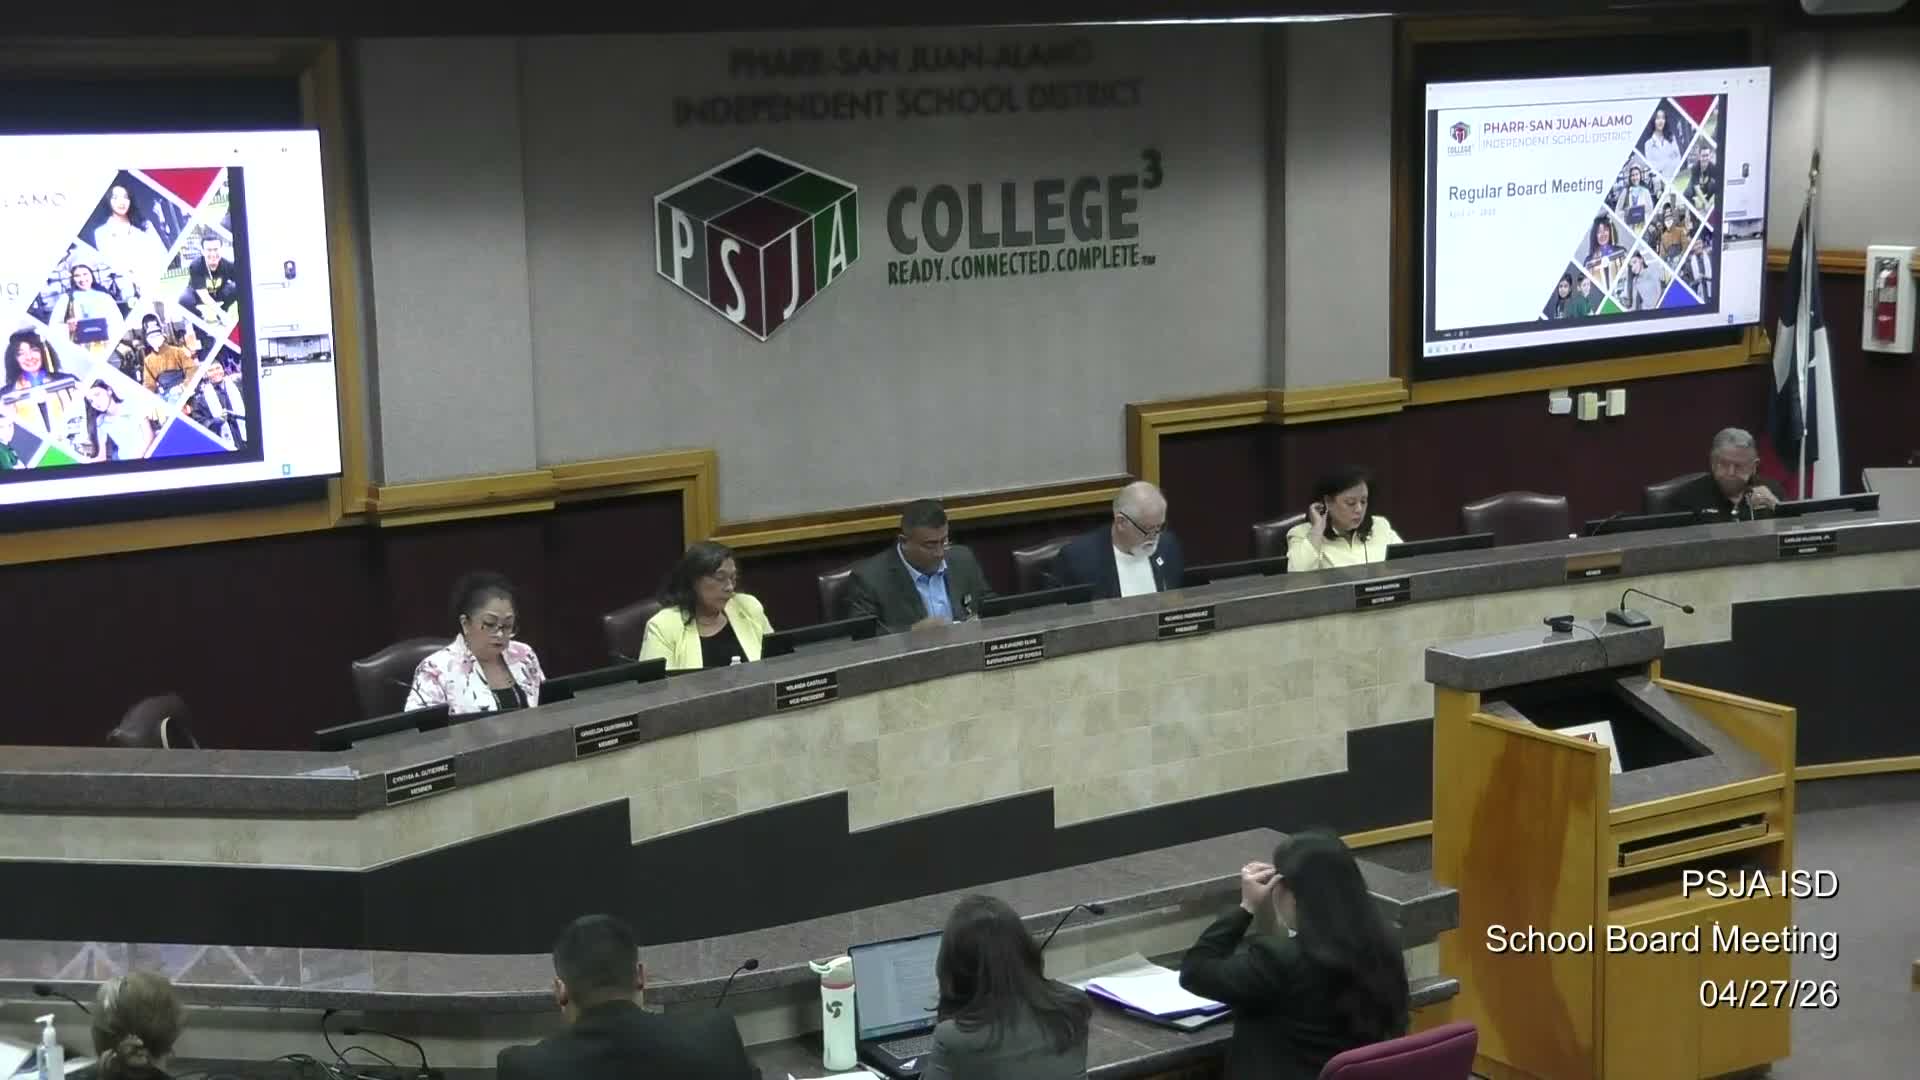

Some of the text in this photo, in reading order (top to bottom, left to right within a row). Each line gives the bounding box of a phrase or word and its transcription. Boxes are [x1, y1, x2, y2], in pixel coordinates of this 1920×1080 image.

[674, 79, 1144, 127] INDEPENDENT SCHOOL DISTRICT
[1483, 114, 1633, 134] PHARR-SAN JUAN-ALAMO
[1449, 177, 1604, 204] Regular Board Meeting
[886, 174, 1140, 255] COLLEGE
